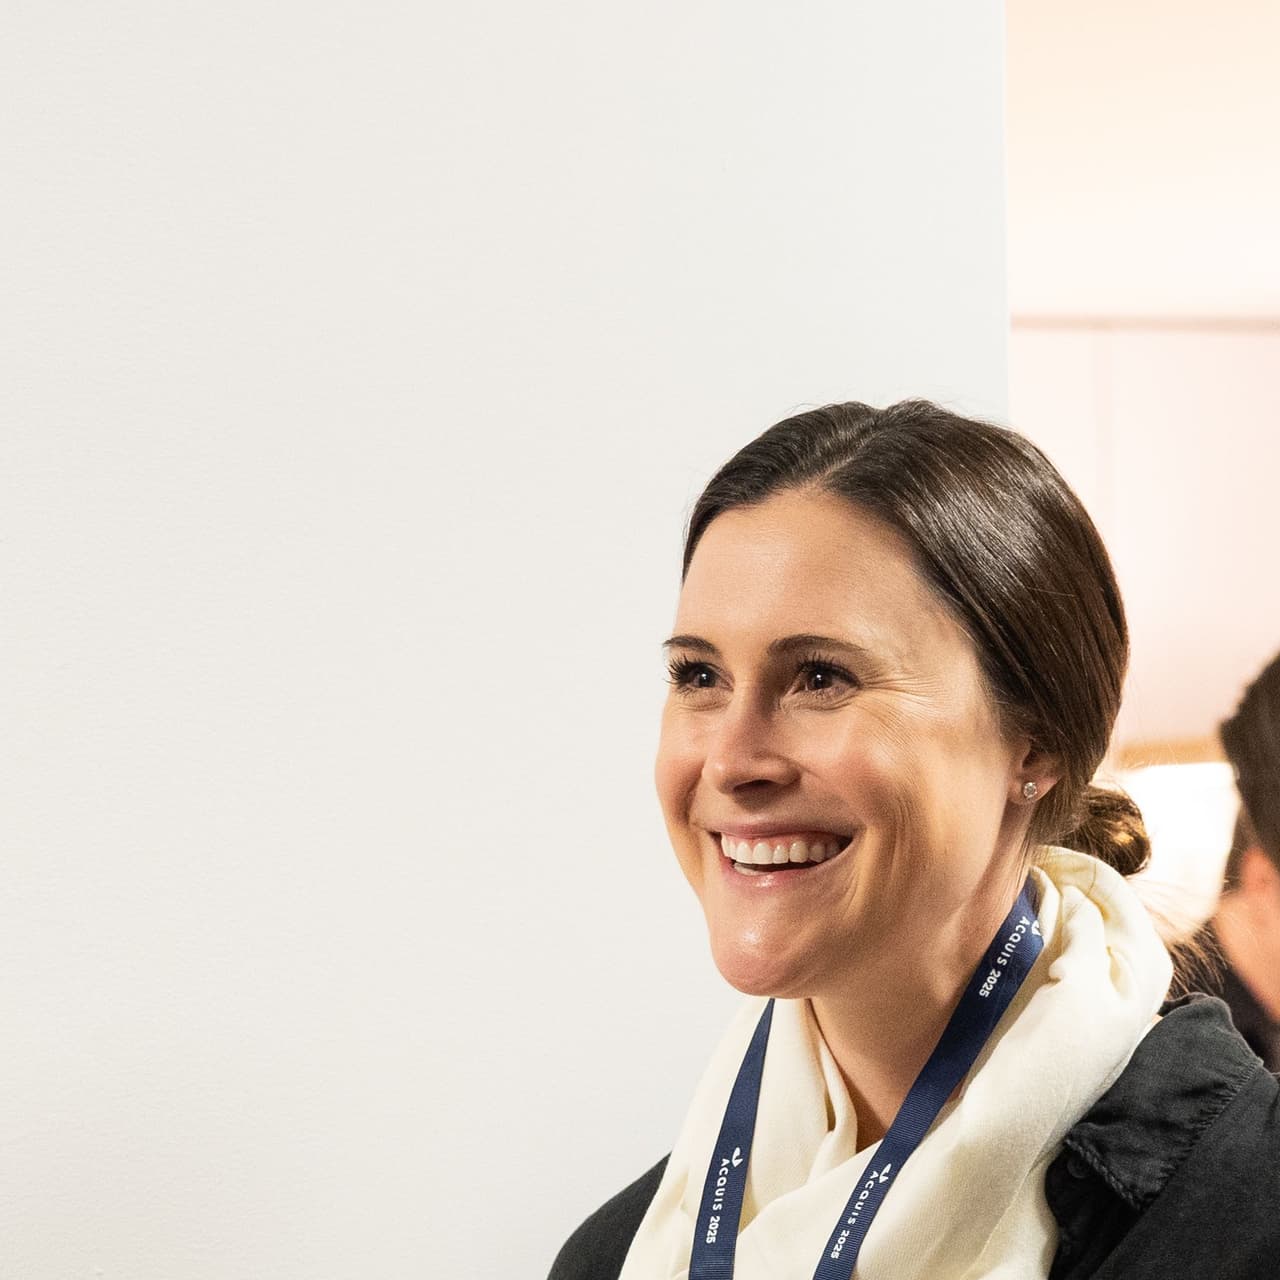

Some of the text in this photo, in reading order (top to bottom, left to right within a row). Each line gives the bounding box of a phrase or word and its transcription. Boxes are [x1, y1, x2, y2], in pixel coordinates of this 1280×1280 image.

[978, 916, 1030, 998] ACQUIS 2025
[705, 1158, 730, 1244] ACQUIS 2025
[830, 1170, 879, 1259] ACQUIS 2025
